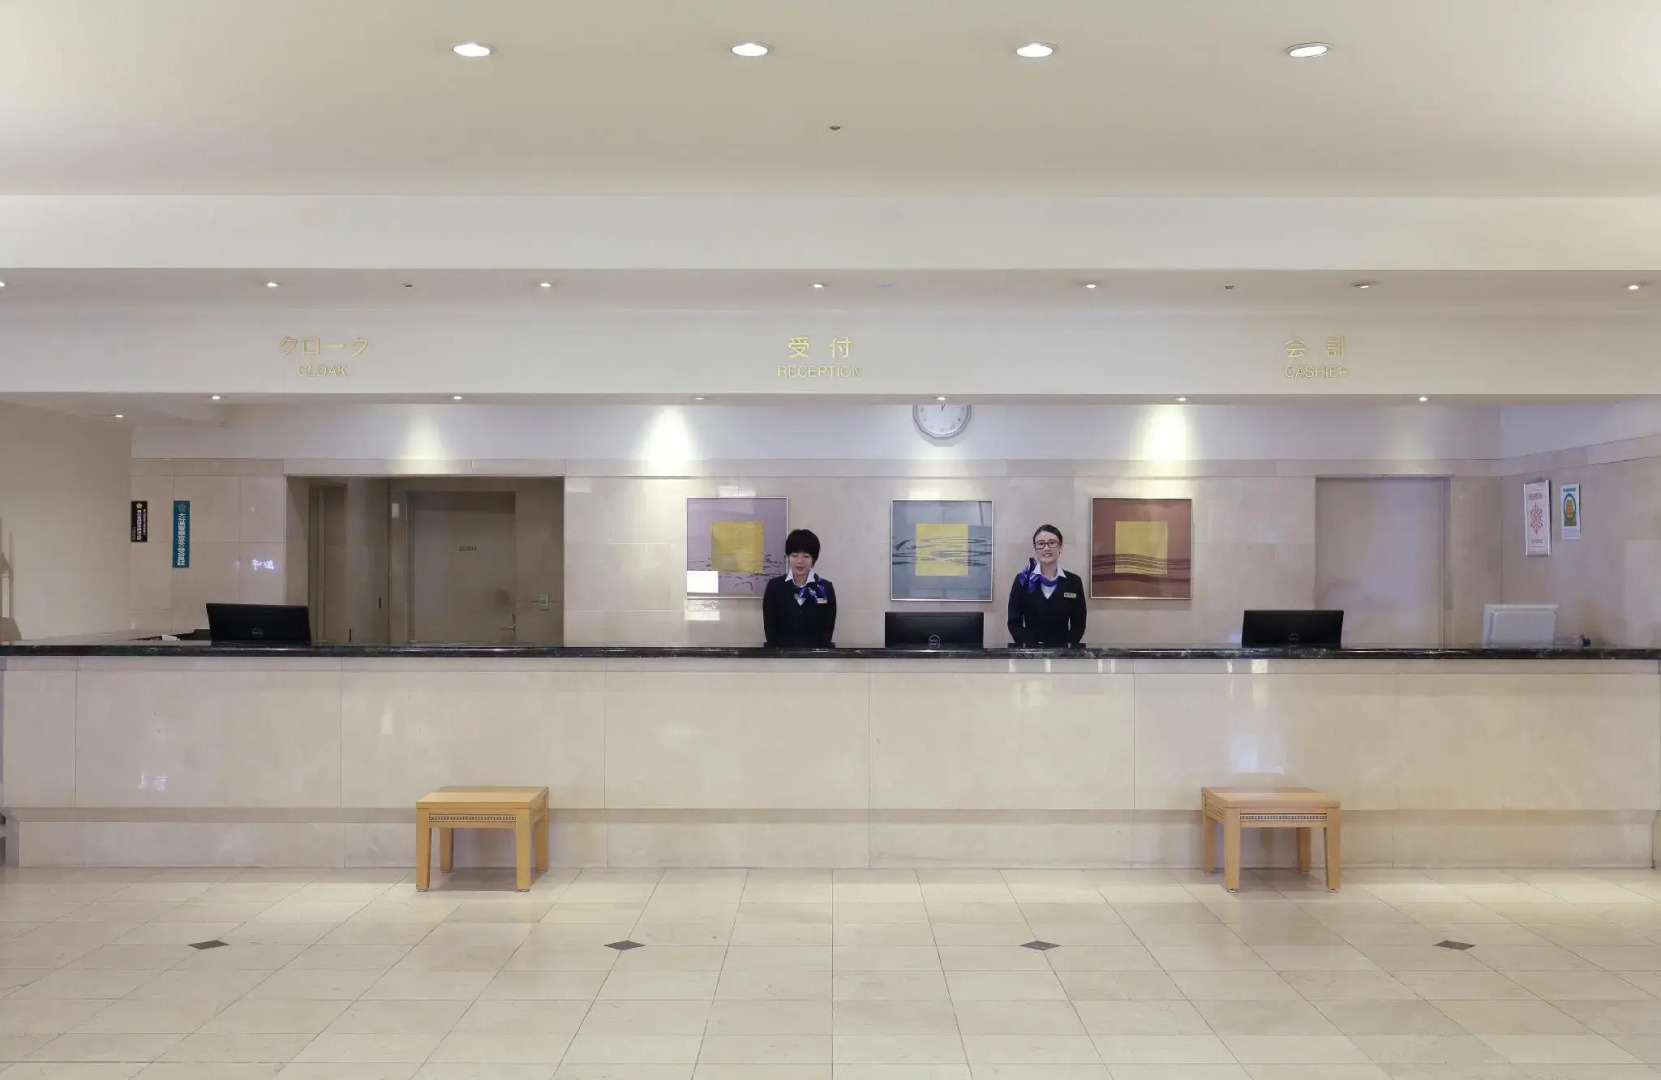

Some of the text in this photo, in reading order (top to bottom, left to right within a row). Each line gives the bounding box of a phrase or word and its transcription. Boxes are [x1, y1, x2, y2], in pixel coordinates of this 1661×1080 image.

[279, 335, 369, 357] クローク
[787, 336, 852, 359] 受付
[298, 363, 348, 378] CLOAK
[777, 365, 862, 378] RECEPTION
